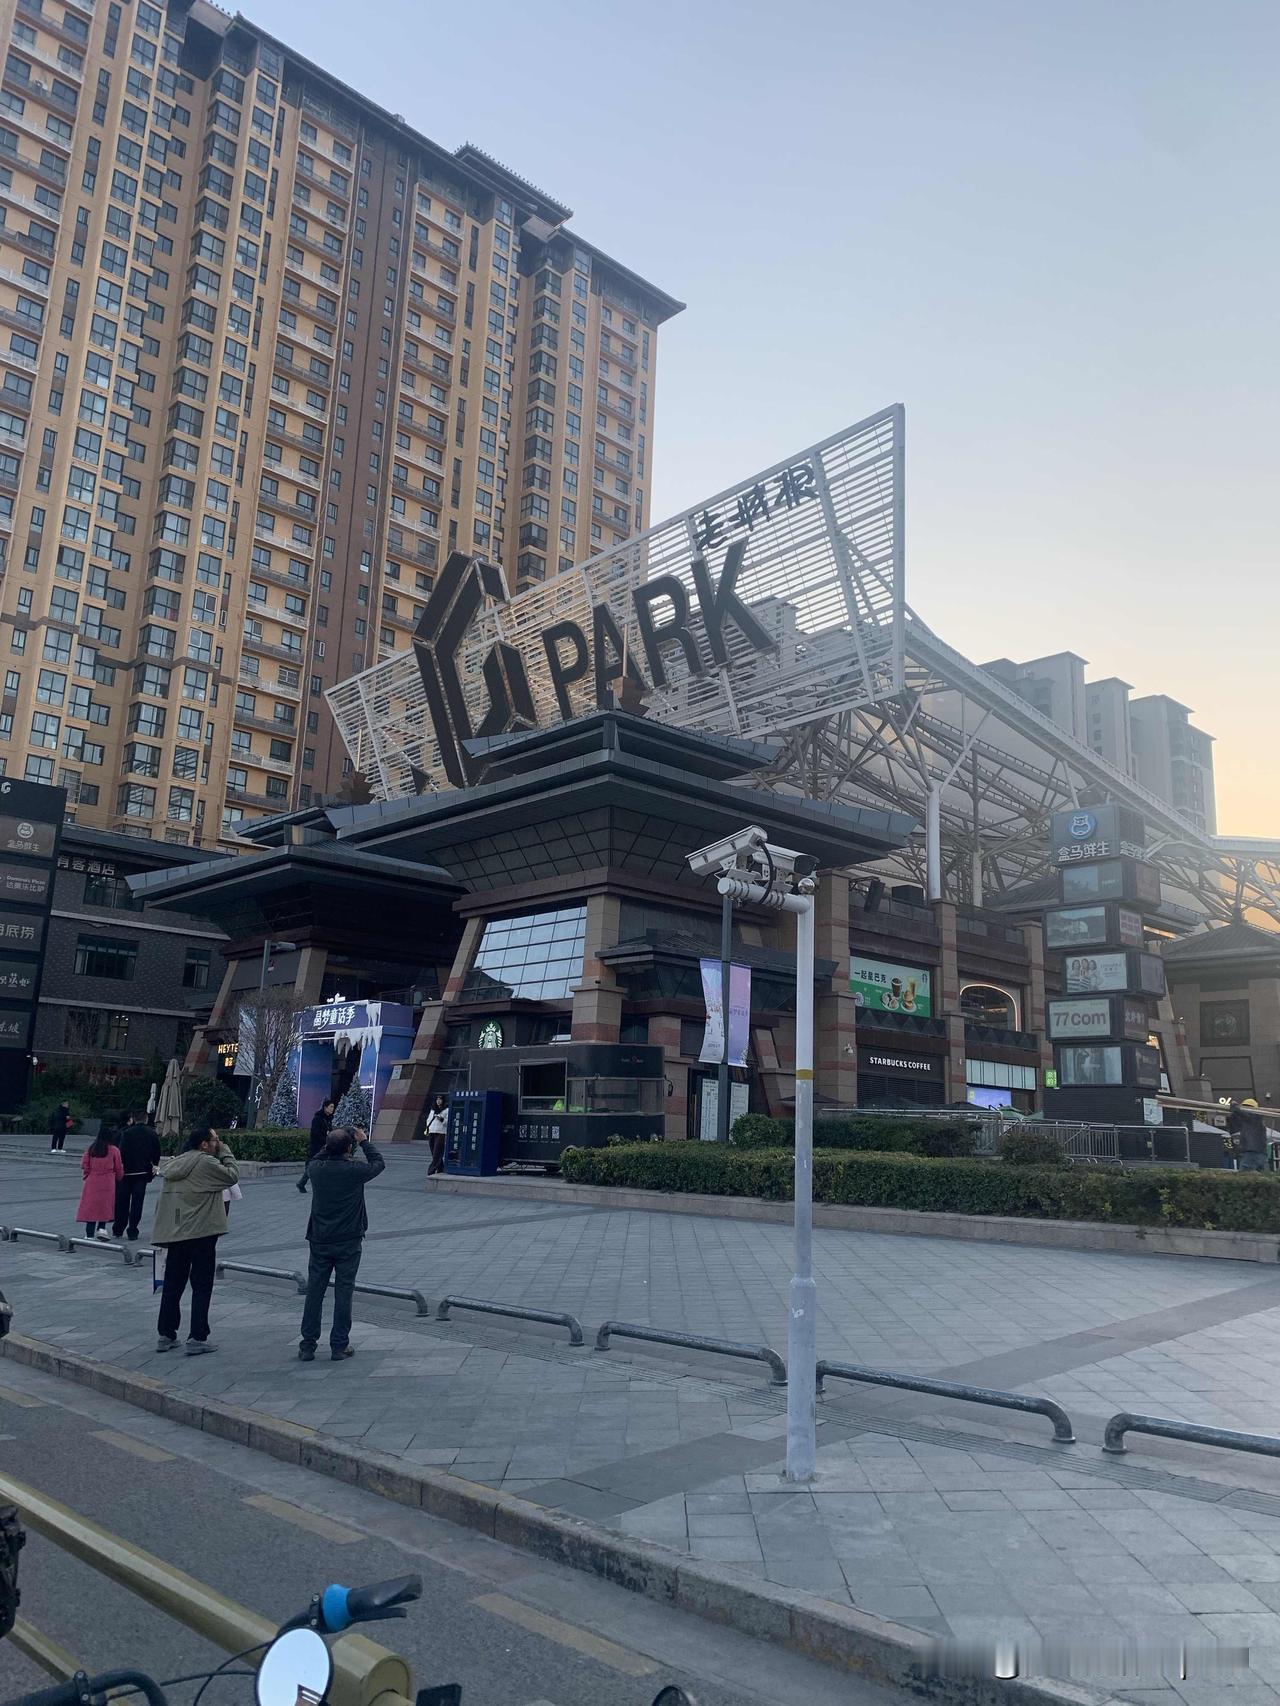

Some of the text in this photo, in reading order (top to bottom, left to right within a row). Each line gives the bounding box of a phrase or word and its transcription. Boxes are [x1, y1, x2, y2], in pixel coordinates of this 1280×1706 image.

[541, 537, 781, 720] PARK
[1058, 841, 1111, 862] 盒马鲜生
[854, 969, 888, 984] 一起星巴克
[217, 1043, 239, 1054] HEYTE
[868, 1055, 932, 1072] STARBUCKS COFFEE
